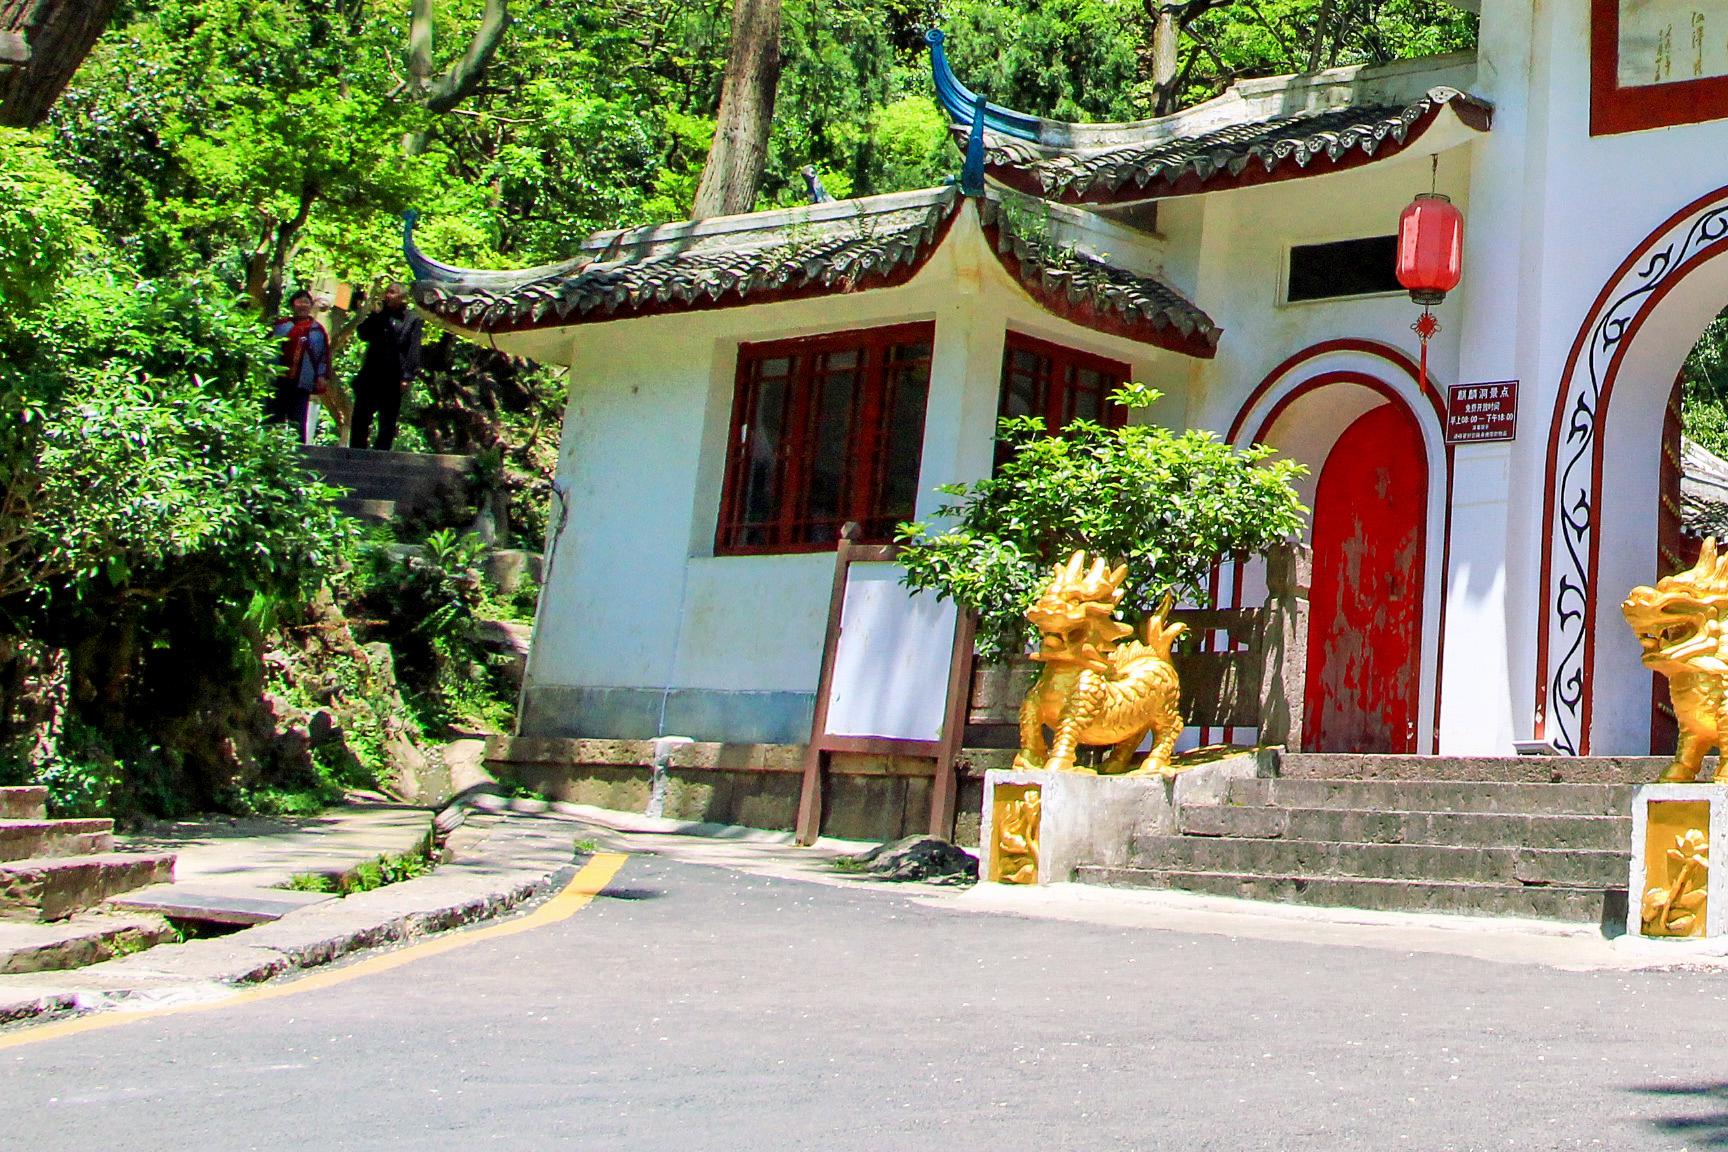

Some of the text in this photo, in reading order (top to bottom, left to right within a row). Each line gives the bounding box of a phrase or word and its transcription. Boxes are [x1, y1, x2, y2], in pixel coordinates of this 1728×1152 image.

[1457, 386, 1509, 400] 麒麟洞景点
